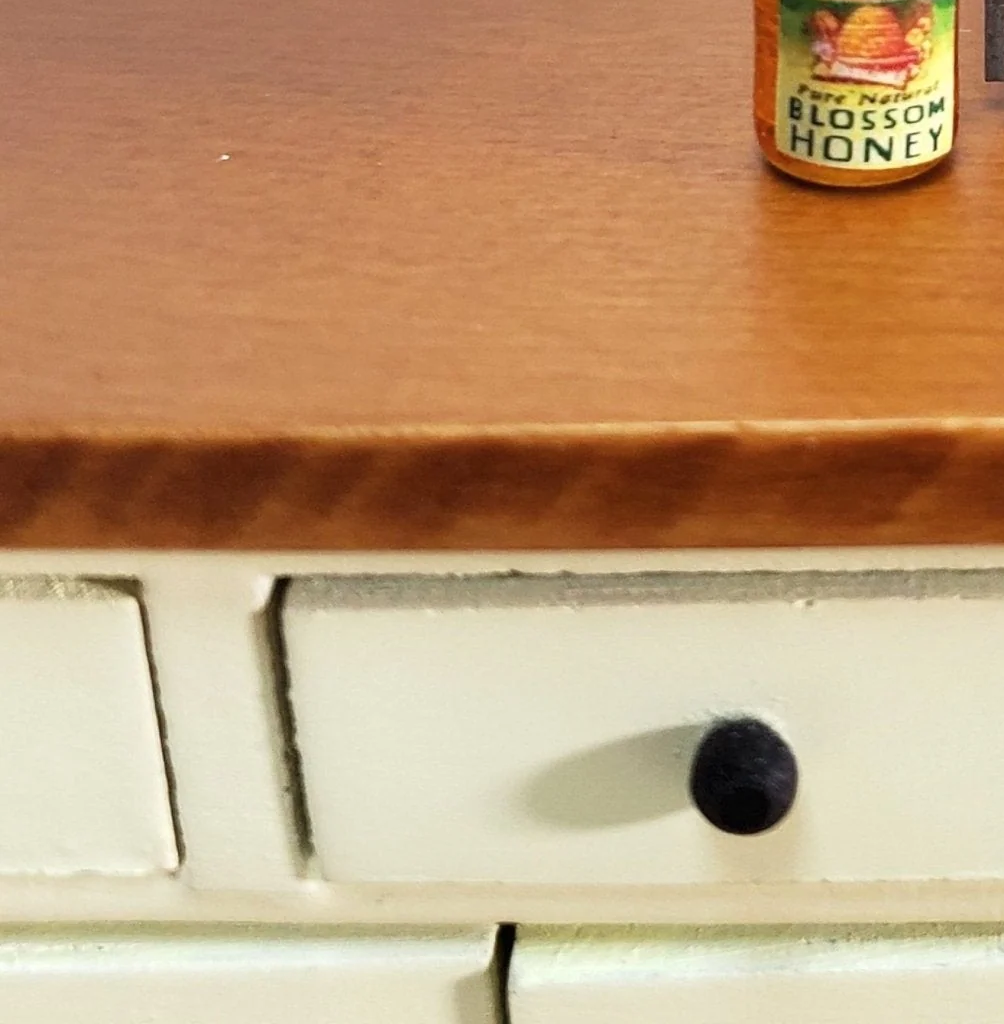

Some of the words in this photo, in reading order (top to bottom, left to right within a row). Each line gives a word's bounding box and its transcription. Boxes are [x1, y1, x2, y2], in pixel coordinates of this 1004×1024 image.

[796, 83, 848, 105] Pure
[857, 80, 940, 106] Natural
[787, 96, 945, 130] BLOSSOM
[789, 123, 943, 163] HONEY
